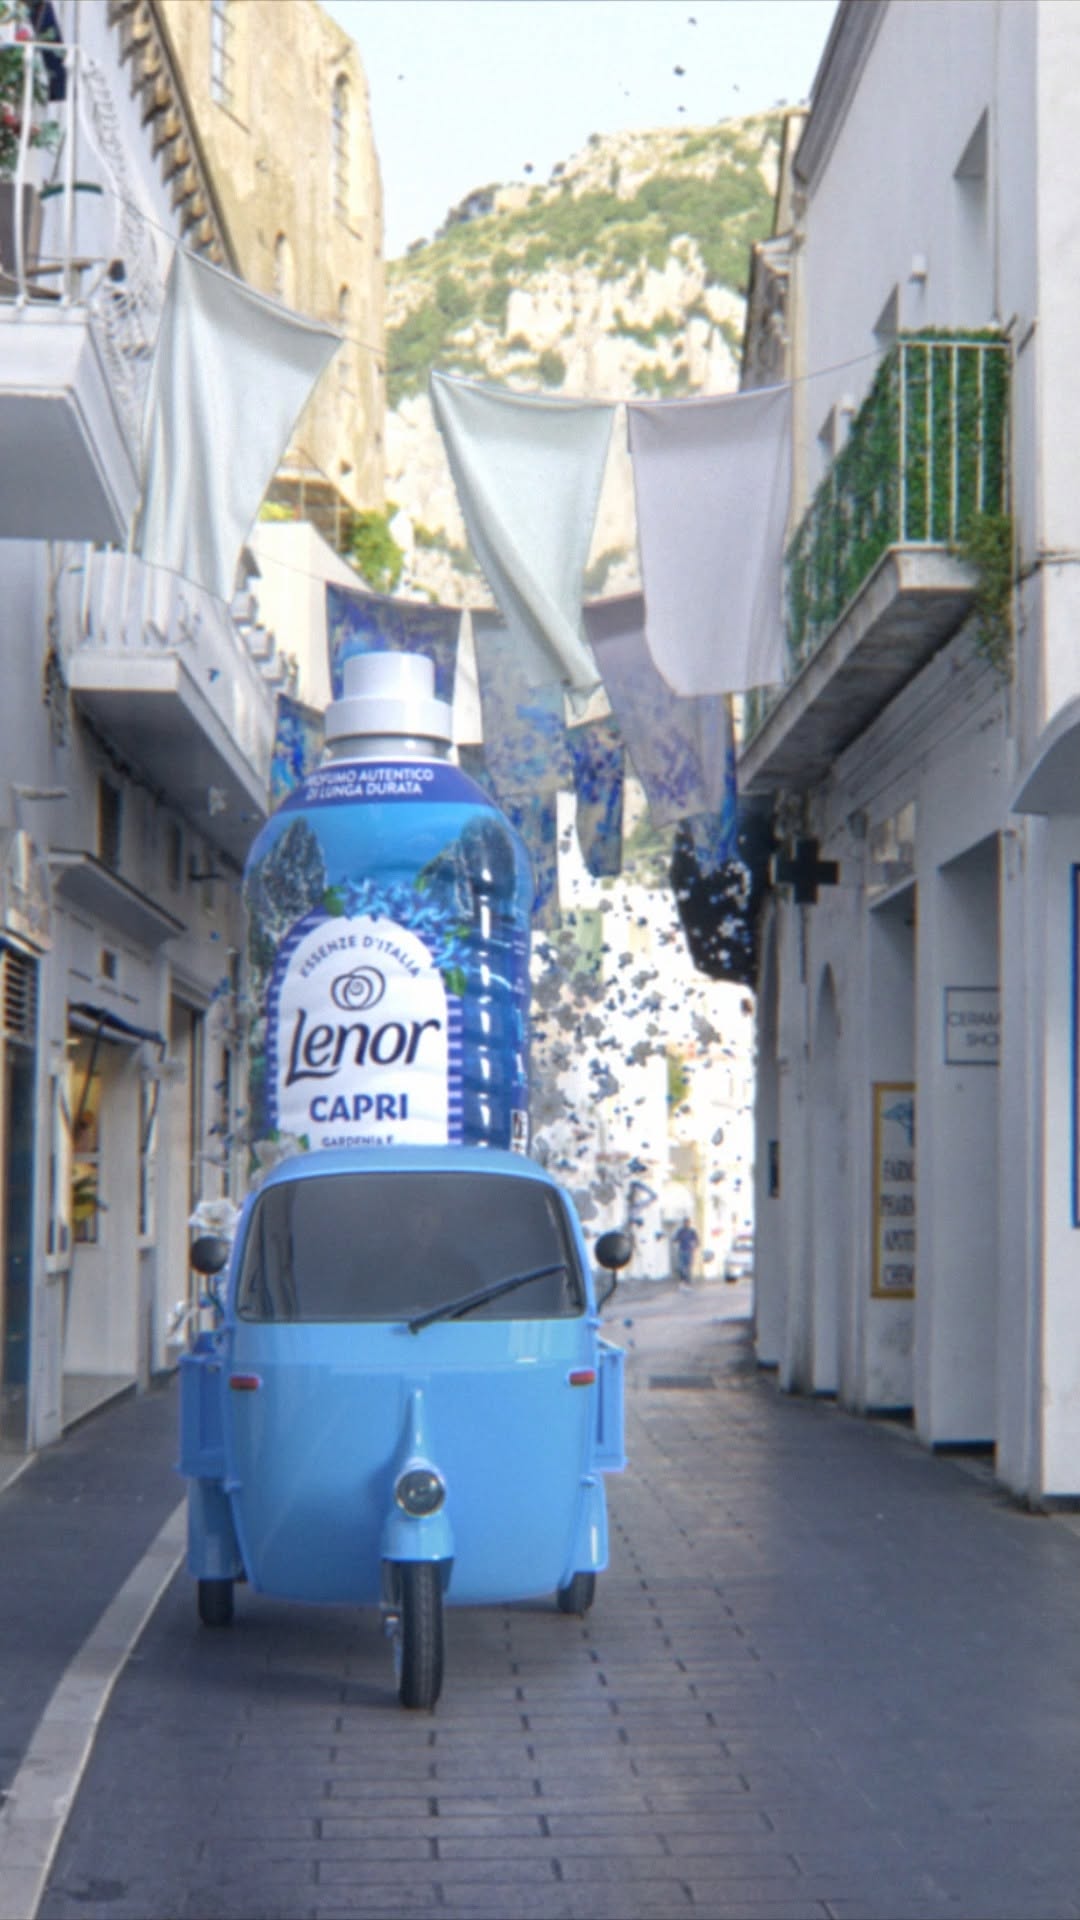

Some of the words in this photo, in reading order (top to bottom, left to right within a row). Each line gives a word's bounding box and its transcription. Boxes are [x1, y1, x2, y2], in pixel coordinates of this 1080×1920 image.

[359, 768, 434, 782] AUTENTICO
[320, 784, 363, 799] LUNGA
[366, 782, 422, 795] DURATA
[300, 935, 357, 978] ESSENZE
[362, 935, 421, 978] D'ITALIA
[285, 1009, 441, 1087] Lenor
[309, 1093, 409, 1123] CAPRI
